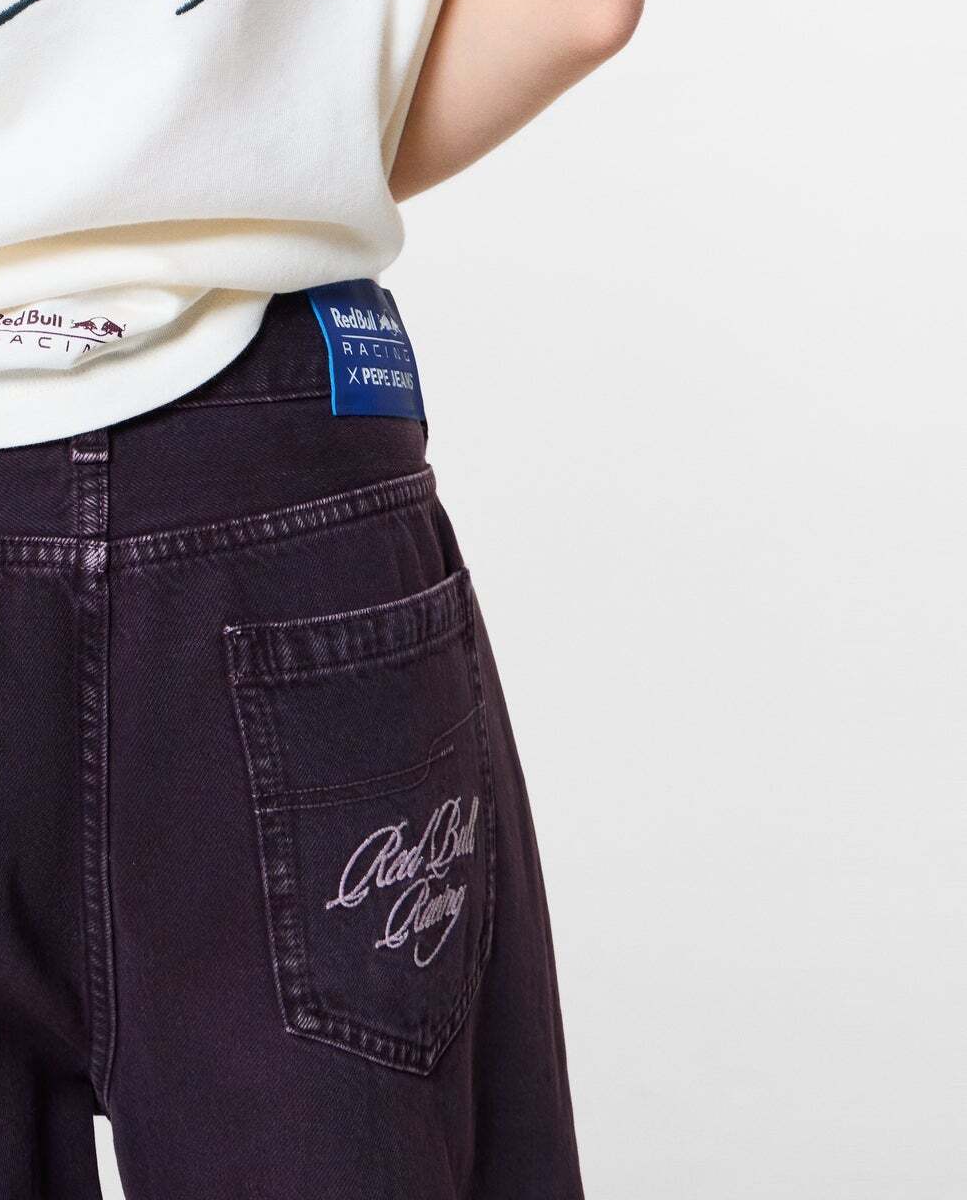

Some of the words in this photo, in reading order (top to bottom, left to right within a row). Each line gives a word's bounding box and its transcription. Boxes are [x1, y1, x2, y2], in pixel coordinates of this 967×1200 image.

[361, 367, 391, 386] PEPE
[390, 369, 414, 391] JEANS
[324, 807, 441, 910] Red
[425, 795, 480, 880] Bull
[374, 874, 468, 968] Racing
